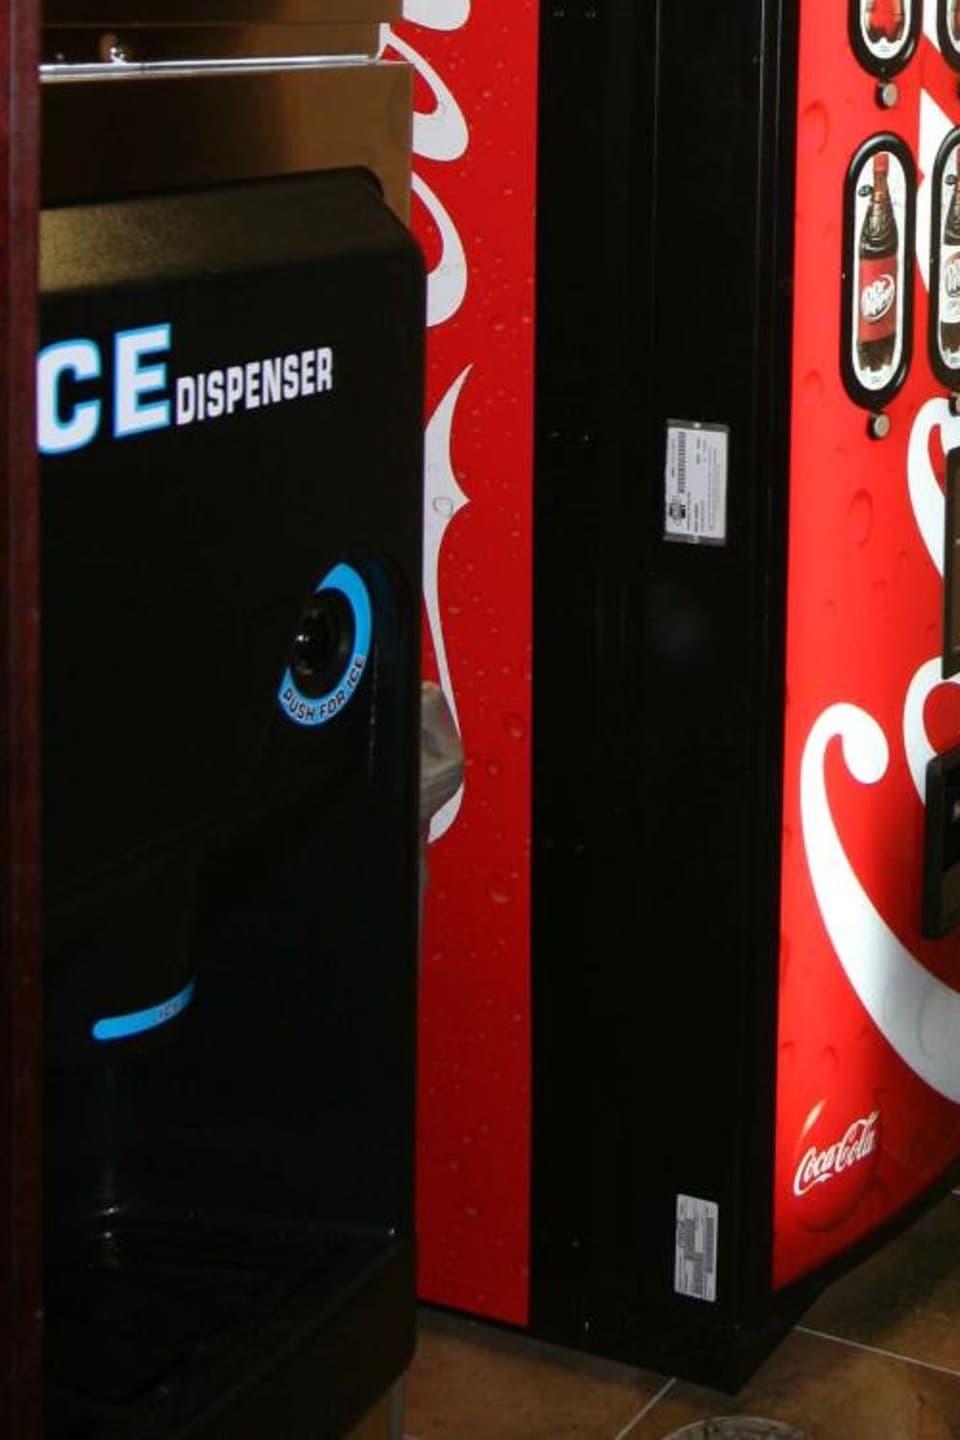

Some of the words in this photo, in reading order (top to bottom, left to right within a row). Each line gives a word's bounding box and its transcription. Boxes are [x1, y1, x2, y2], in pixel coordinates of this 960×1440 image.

[36, 322, 172, 454] CE
[174, 346, 333, 426] DISPENSER
[283, 687, 314, 720] PUSH
[320, 690, 346, 718] FOR
[346, 657, 367, 688] ICE
